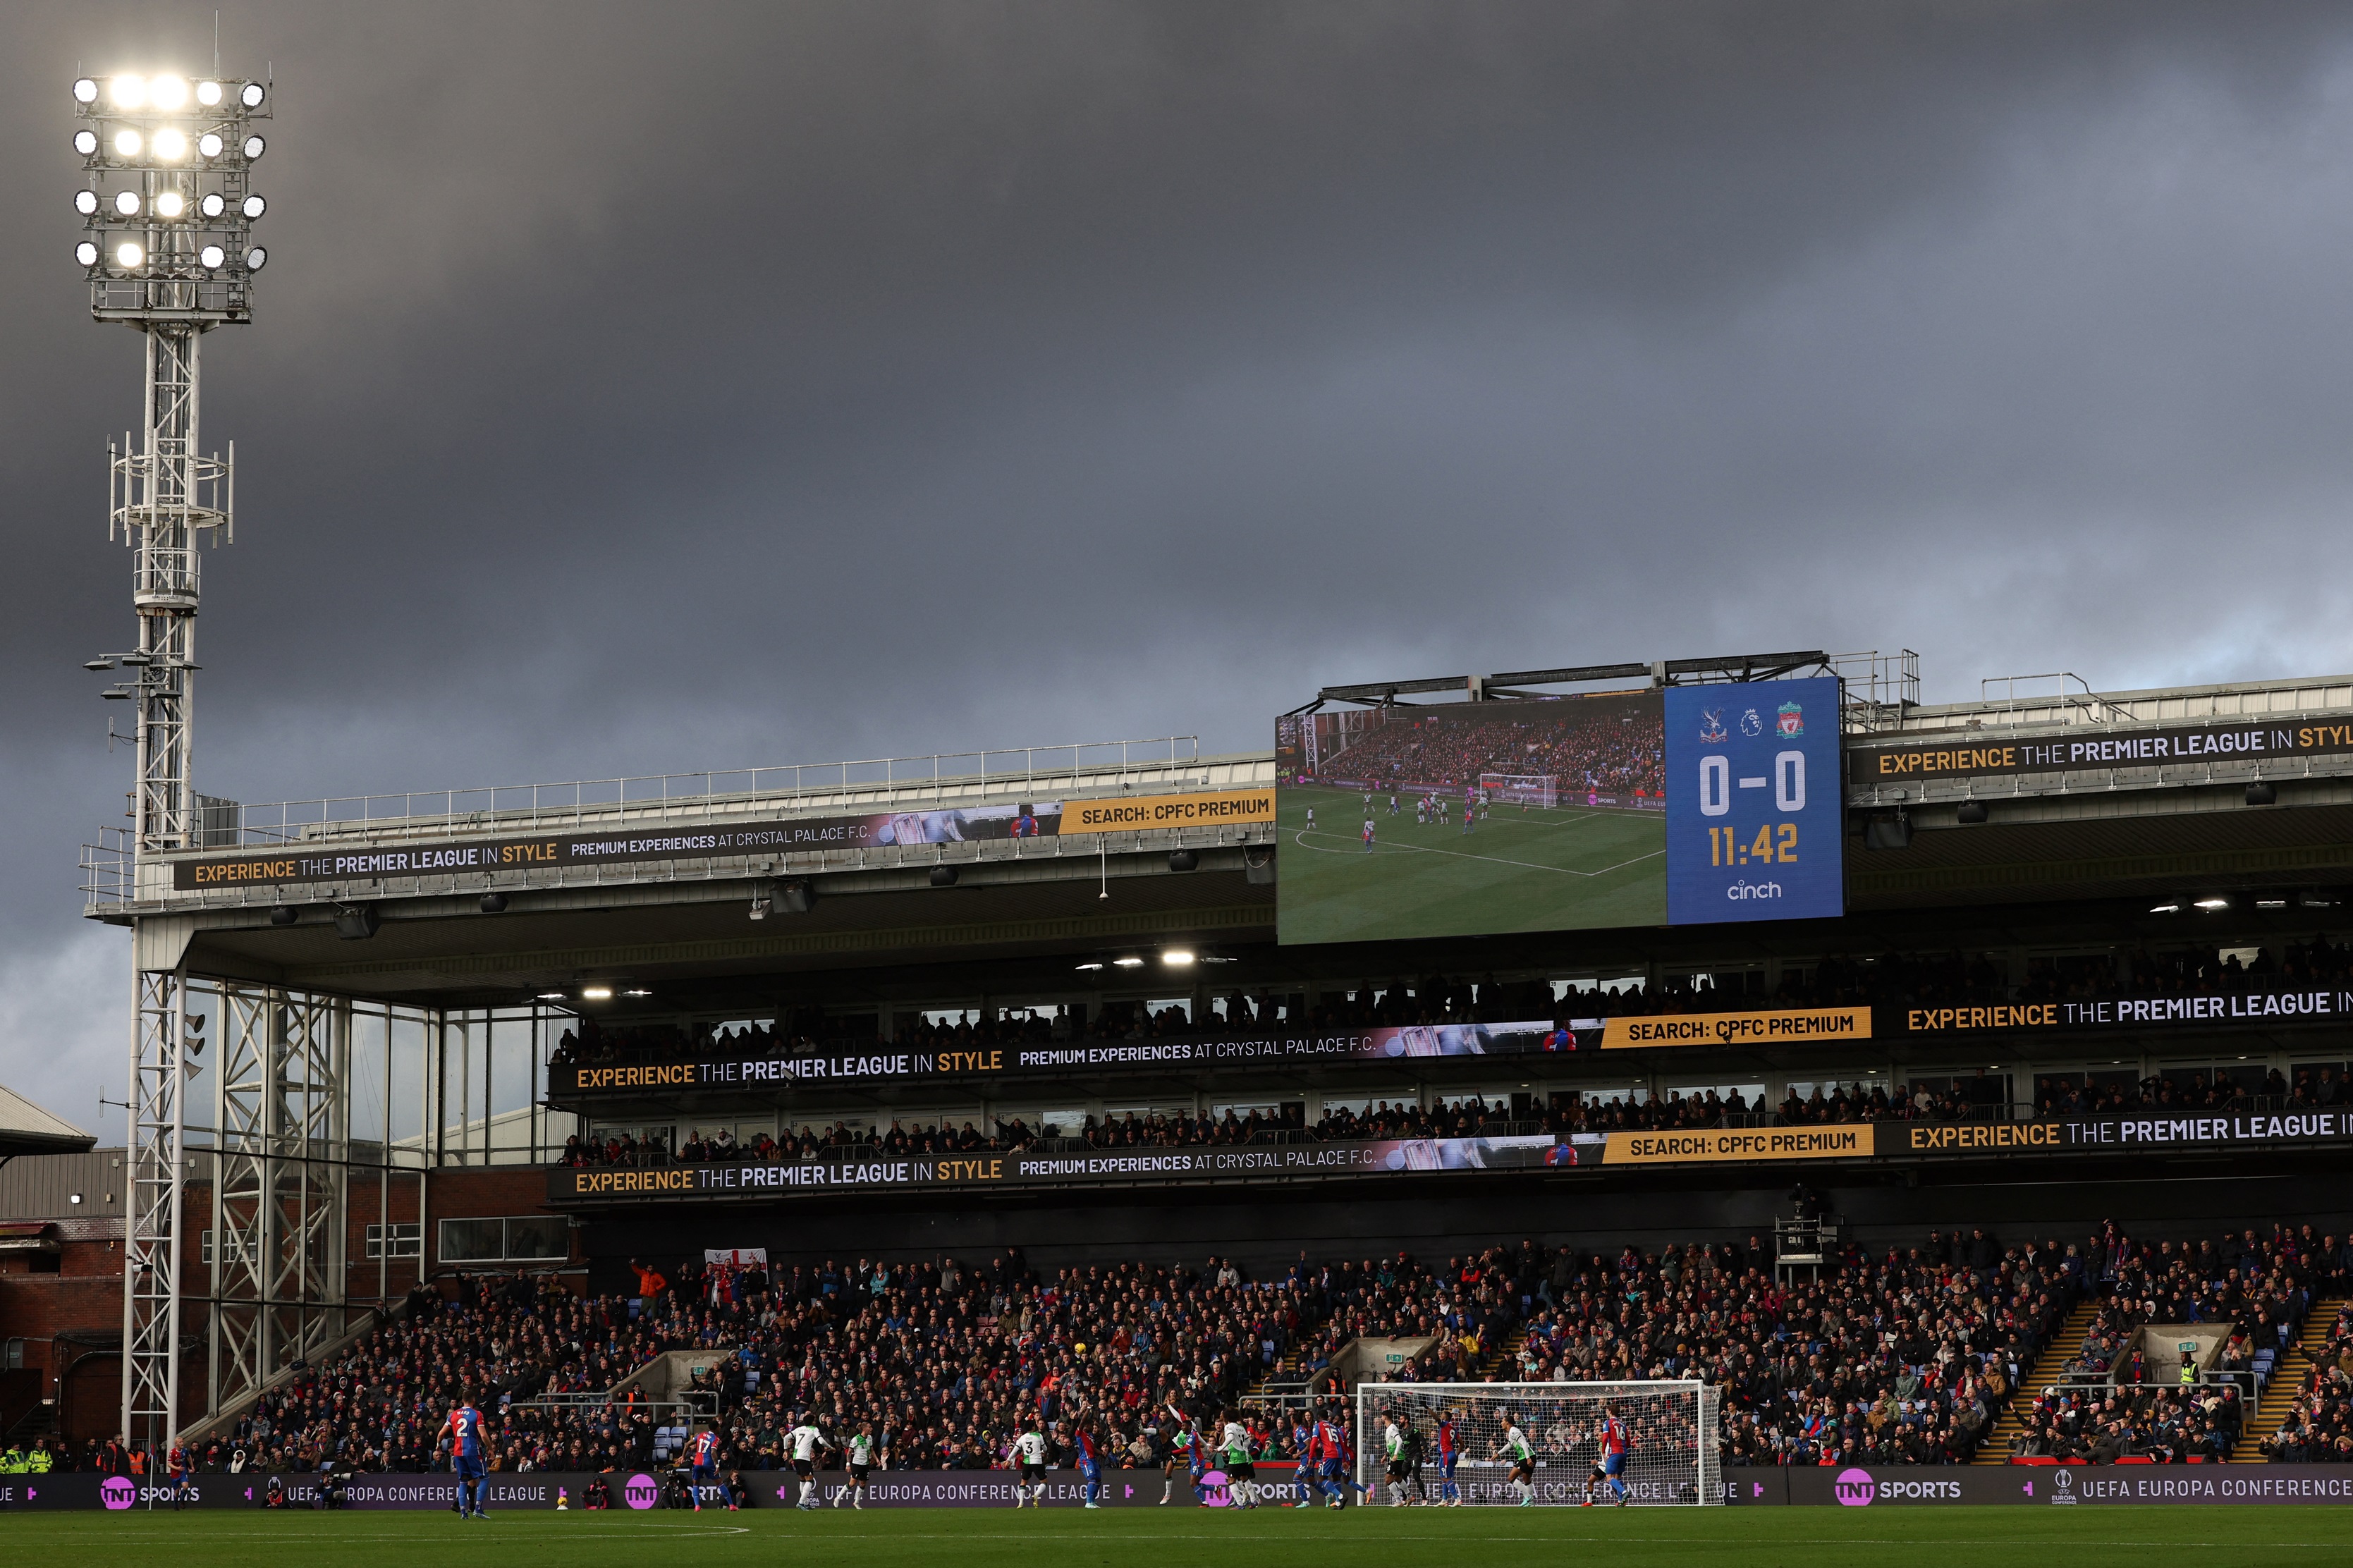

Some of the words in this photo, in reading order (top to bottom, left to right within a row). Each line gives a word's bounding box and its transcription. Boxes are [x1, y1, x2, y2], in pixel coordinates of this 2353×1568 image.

[1879, 747, 2015, 774] EXPERIENCE
[2021, 744, 2065, 766] THE
[2070, 736, 2168, 762] PREMIER
[2174, 730, 2265, 756] LEAGUE
[2271, 730, 2292, 749] IN
[195, 860, 295, 882] EXPERIENCE
[300, 858, 331, 876] THE
[336, 852, 408, 873] PREMIER
[412, 847, 477, 869] LEAGUE
[482, 846, 498, 864] IN
[502, 843, 557, 863] STYLE
[571, 839, 626, 857] PREMIUM
[629, 834, 716, 854] EXPERIENCES
[718, 834, 733, 847] AT
[736, 829, 792, 845] CRYSTAL
[795, 828, 845, 844] PALACE
[848, 826, 872, 840] F.C.
[1082, 806, 1151, 824] SEARCH:
[1154, 802, 1194, 821] CPFC
[1198, 797, 1269, 818] PREMIUM
[1709, 823, 1797, 866] 11:42
[1728, 879, 1782, 900] cinch
[1908, 1004, 2058, 1030] EXPERIENCE
[2063, 1002, 2112, 1024] THE
[2117, 996, 2225, 1022] PREMIER
[2231, 992, 2330, 1017] LEAGUE
[577, 1065, 695, 1088] EXPERIENCE
[699, 1062, 737, 1082] THE
[742, 1059, 826, 1081] PREMIER
[831, 1055, 909, 1077] LEAGUE
[914, 1053, 932, 1074] IN
[938, 1051, 1003, 1072] STYLE
[1020, 1048, 1085, 1066] PREMIUM
[1089, 1043, 1192, 1063] EXPERIENCES
[1194, 1042, 1213, 1058] AT
[1216, 1039, 1283, 1058] CRYSTAL
[1286, 1037, 1345, 1055] PALACE
[1350, 1036, 1376, 1052] F.C.
[1629, 1020, 1711, 1041] SEARCH:
[1715, 1017, 1764, 1038] CPFC
[1768, 1015, 1854, 1035] PREMIUM
[1910, 1124, 2060, 1149] EXPERIENCE
[2066, 1121, 2115, 1144] THE
[2120, 1117, 2228, 1142] PREMIER
[2234, 1114, 2335, 1138] LEAGUE
[576, 1170, 693, 1192] EXPERIENCE
[699, 1168, 736, 1188] THE
[741, 1165, 826, 1187] PREMIER
[830, 1162, 908, 1184] LEAGUE
[914, 1161, 932, 1180] IN
[938, 1159, 1003, 1180] STYLE
[1020, 1158, 1085, 1175] PREMIUM
[1089, 1154, 1192, 1173] EXPERIENCES
[1194, 1153, 1213, 1169] AT
[1216, 1151, 1283, 1169] CRYSTAL
[1287, 1149, 1345, 1166] PALACE
[1350, 1149, 1378, 1164] F.C.
[1630, 1136, 1712, 1156] SEARCH:
[1718, 1134, 1766, 1153] CPFC
[1771, 1132, 1856, 1151] PREMIUM
[456, 1418, 468, 1437] 2
[1325, 1427, 1340, 1443] 15
[1449, 1429, 1456, 1440] 9
[1614, 1425, 1626, 1440] 16
[698, 1438, 711, 1454] 17
[797, 1433, 806, 1447] 7
[1025, 1441, 1034, 1454] 3
[101, 1488, 135, 1502] TNT
[345, 1486, 384, 1501] ROPA
[389, 1486, 471, 1501] CONFERE
[489, 1486, 546, 1501] LEAGUE
[625, 1486, 658, 1502] TNT
[869, 1485, 920, 1501] EUROPA
[1248, 1483, 1311, 1500] PORTS
[1835, 1482, 1874, 1498] TNT
[1880, 1481, 1962, 1498] SPORTS
[2082, 1481, 2130, 1497] UEFA
[2139, 1479, 2216, 1497] EUROPA
[2222, 1478, 2353, 1496] CONFERENCE
